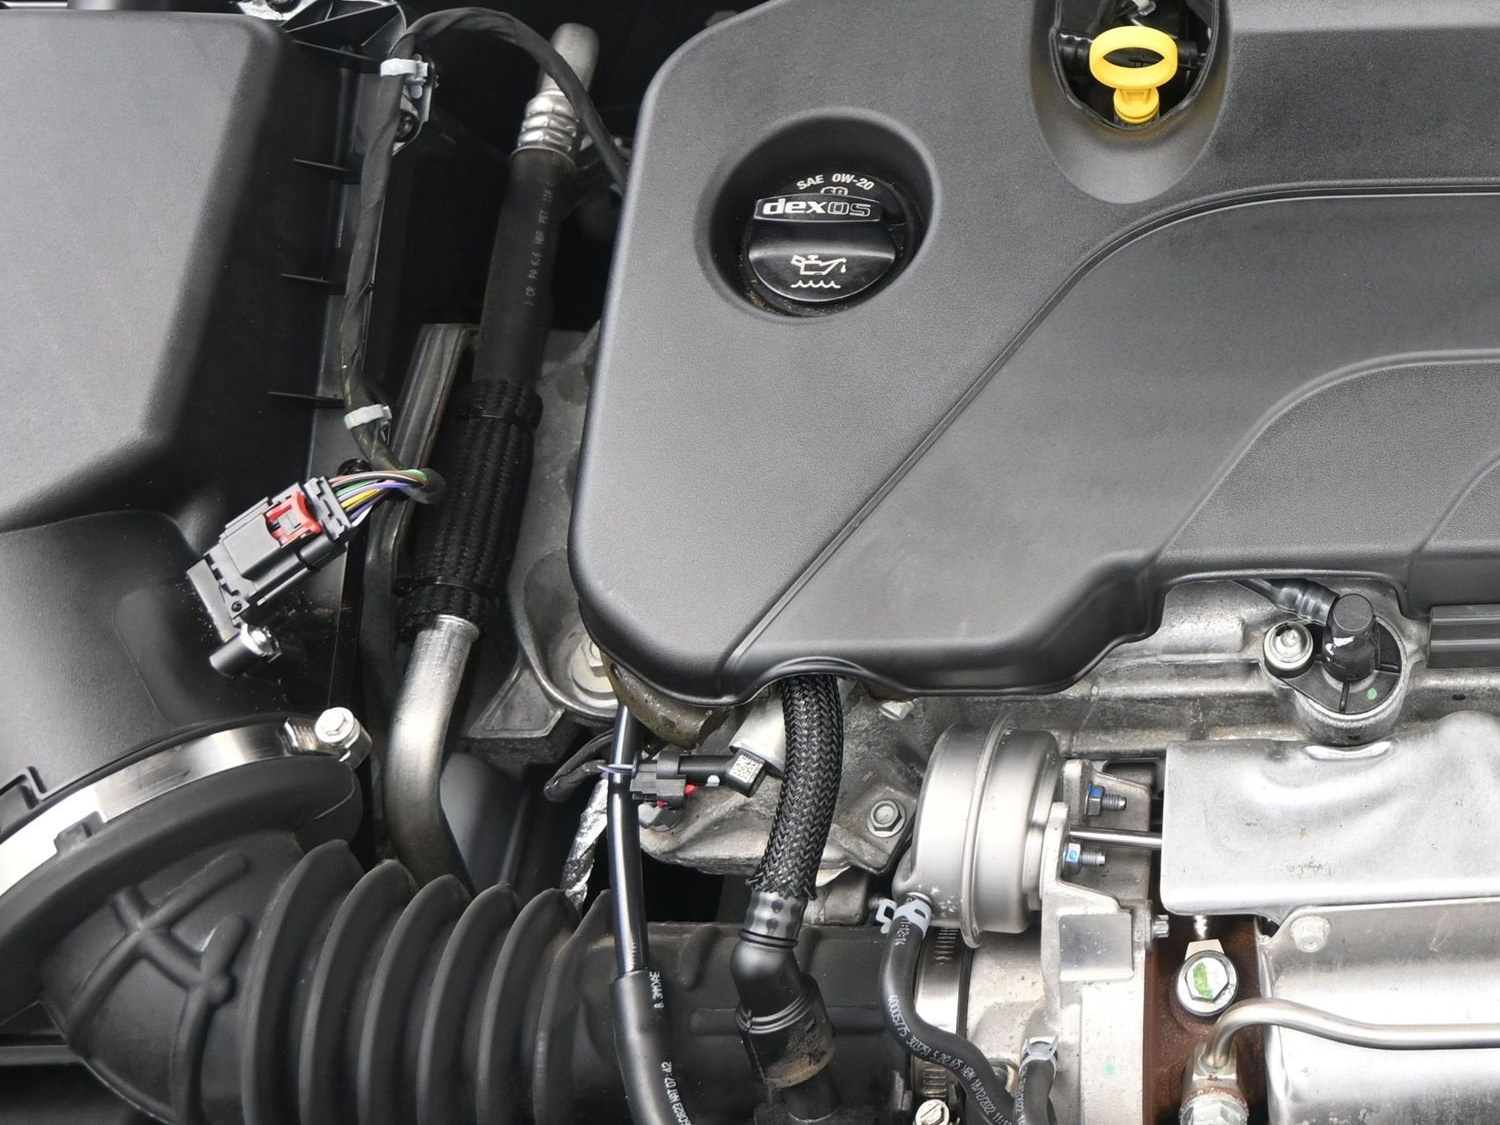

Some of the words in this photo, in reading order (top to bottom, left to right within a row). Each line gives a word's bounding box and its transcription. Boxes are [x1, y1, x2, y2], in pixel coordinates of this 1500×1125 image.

[796, 174, 825, 190] SAE
[832, 173, 875, 191] 0W-20
[763, 198, 871, 217] dexos
[661, 1061, 677, 1088] 07:42
